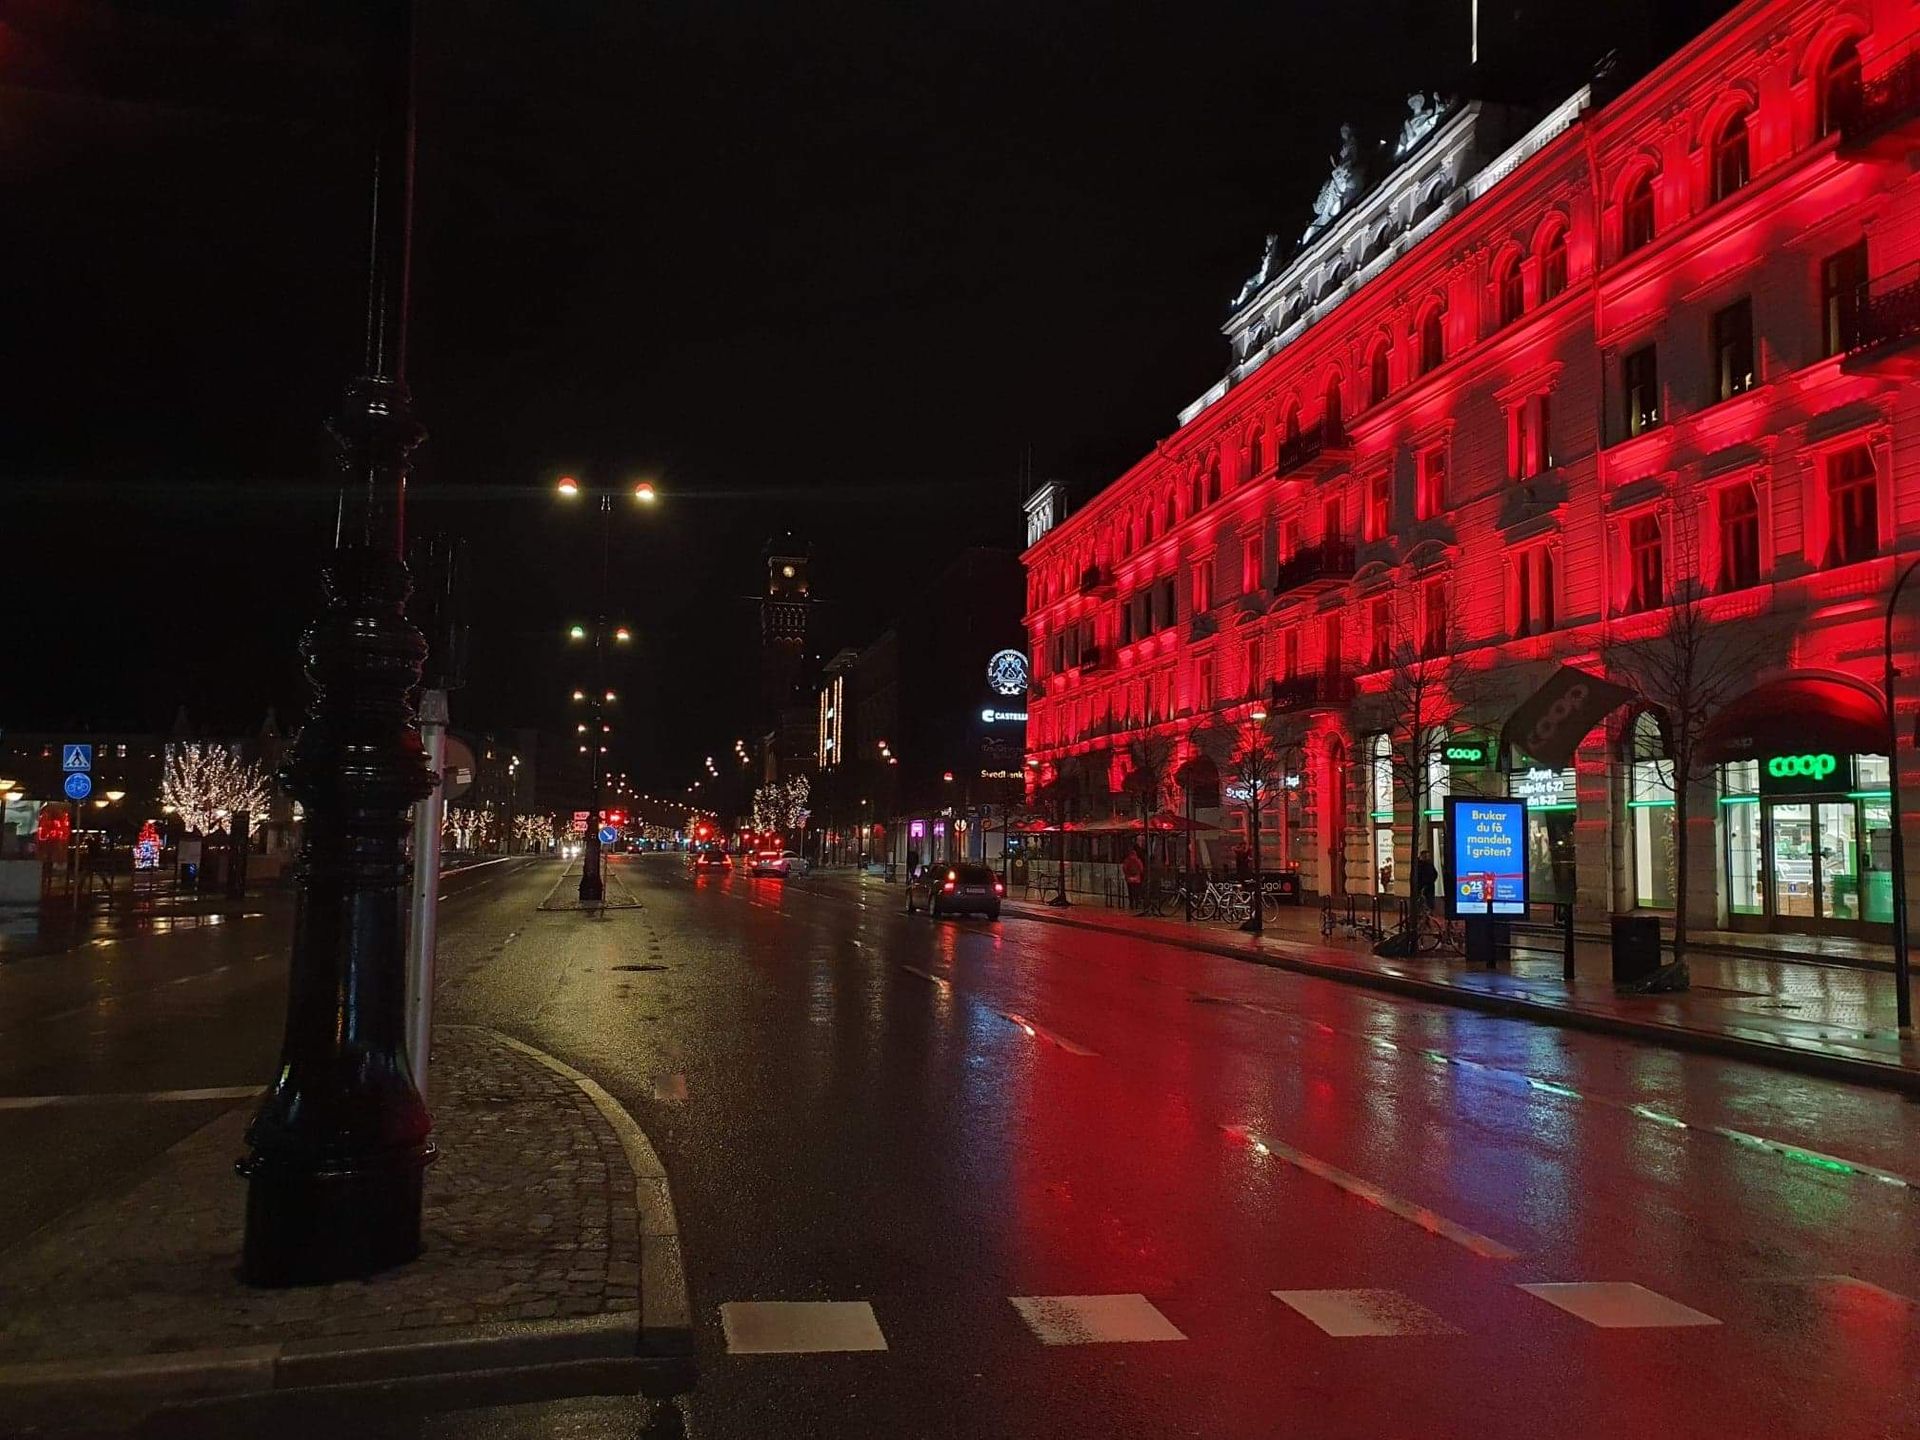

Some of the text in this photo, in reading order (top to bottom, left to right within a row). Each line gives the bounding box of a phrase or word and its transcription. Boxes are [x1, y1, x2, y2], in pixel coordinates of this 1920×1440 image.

[1447, 748, 1481, 761] coop
[1769, 754, 1836, 780] coop
[1472, 810, 1507, 820] Brukar
[1477, 823, 1489, 832] du
[1467, 836, 1511, 845] mandeln
[1472, 847, 1512, 858] gröten?
